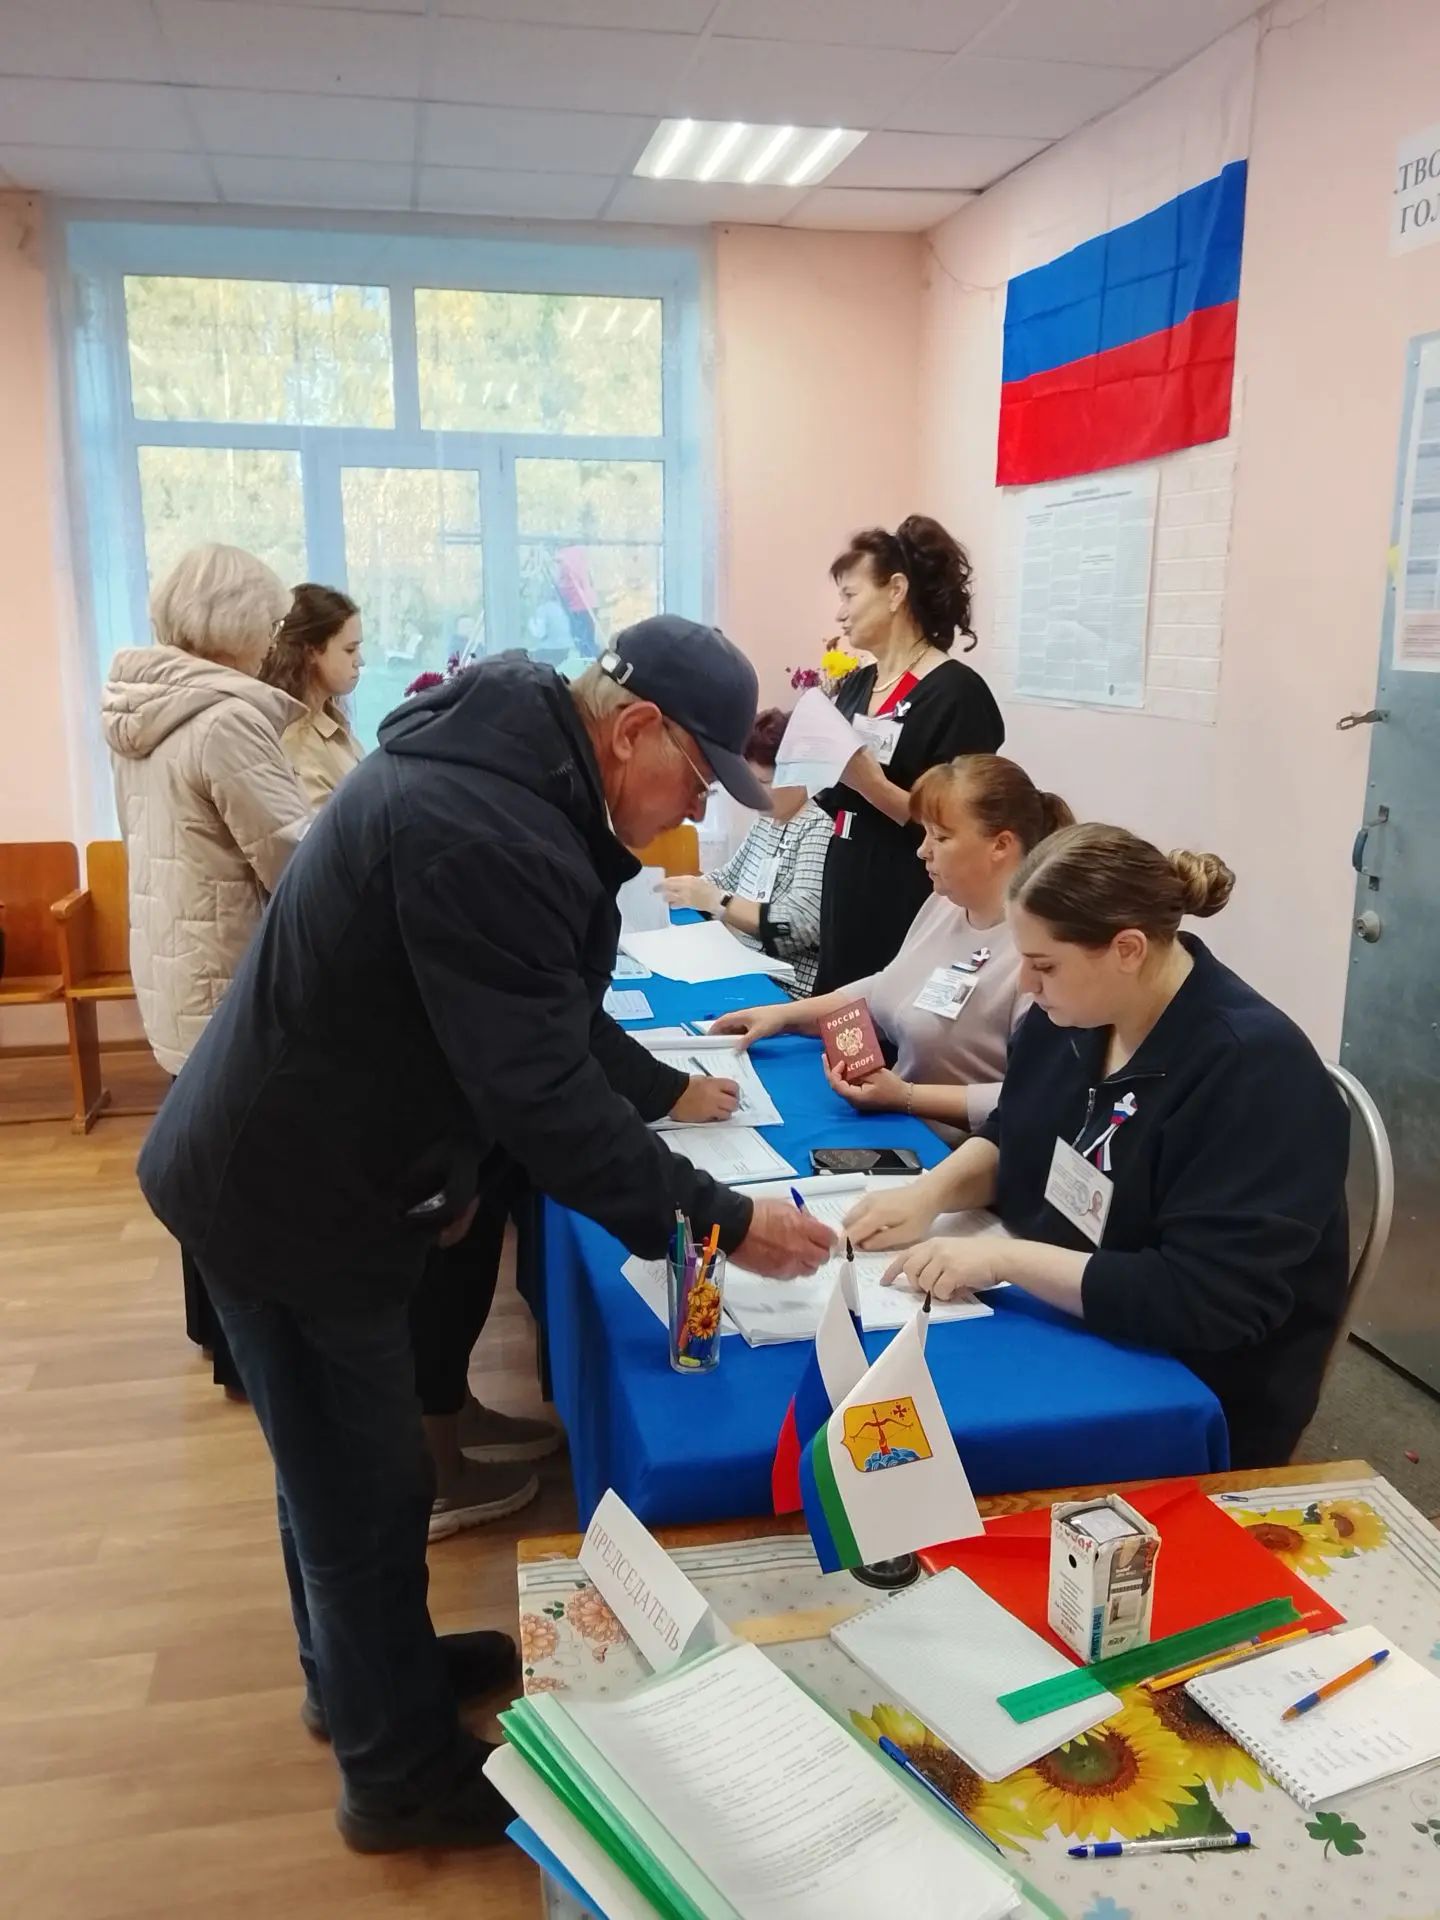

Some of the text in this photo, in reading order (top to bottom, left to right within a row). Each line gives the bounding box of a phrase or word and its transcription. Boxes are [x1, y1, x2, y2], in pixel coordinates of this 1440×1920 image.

[827, 1008, 860, 1029] РОССИЯ
[847, 1053, 875, 1072] АСПОРТ
[588, 1522, 681, 1652] ПРЕДСЕДАТЕЛЬ
